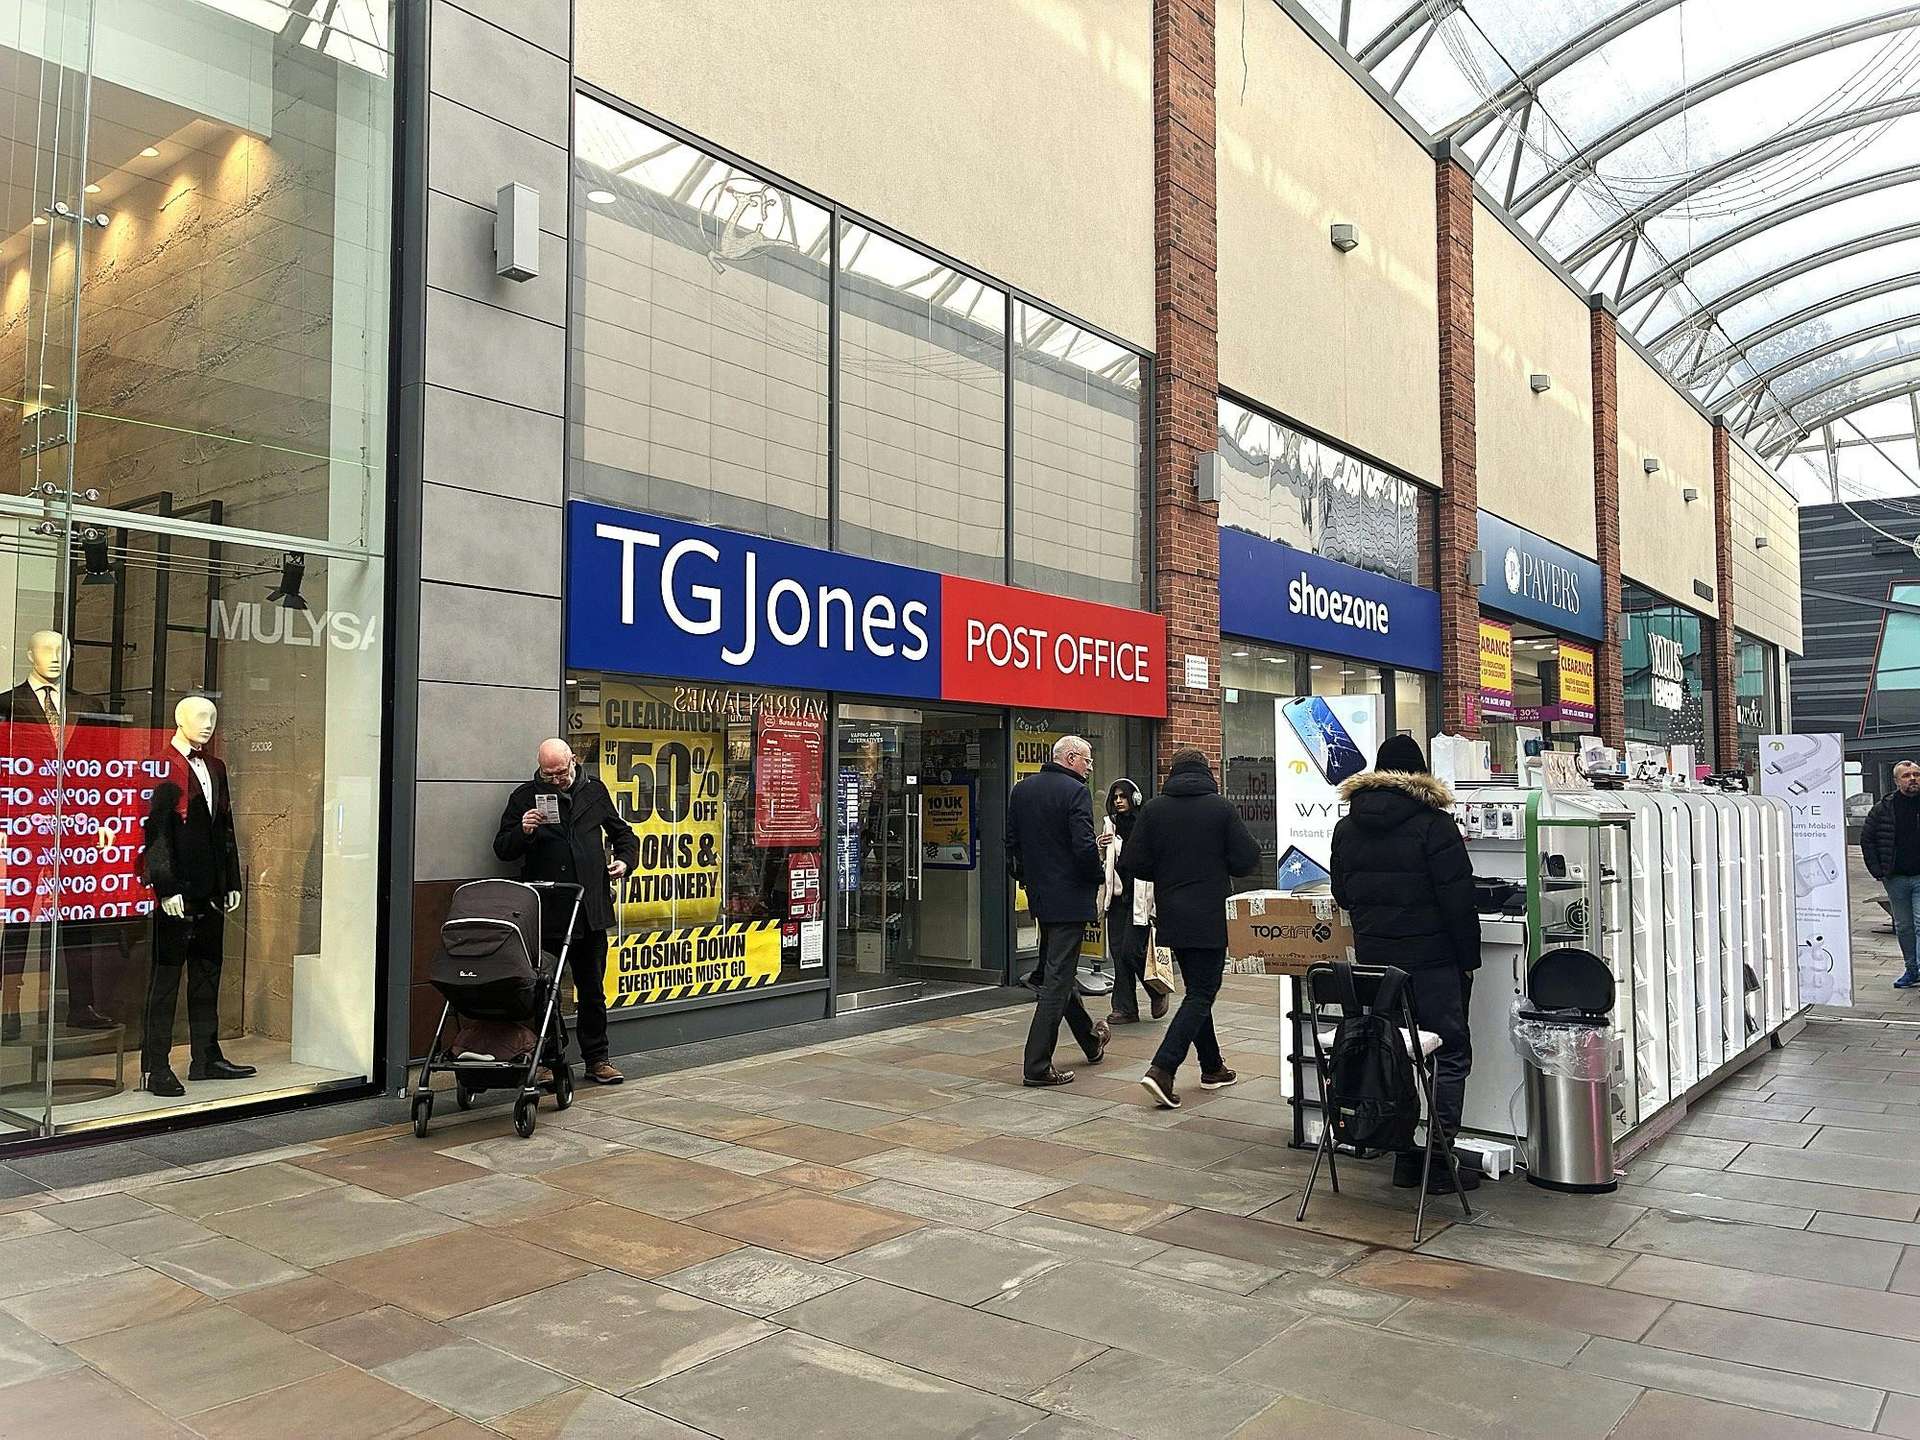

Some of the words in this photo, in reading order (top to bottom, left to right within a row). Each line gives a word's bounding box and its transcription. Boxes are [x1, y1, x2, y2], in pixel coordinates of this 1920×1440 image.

[1522, 552, 1580, 615] PAVERS
[1288, 570, 1390, 635] shoezone
[966, 619, 1048, 670] POST
[1054, 633, 1150, 683] OFFICE
[1480, 636, 1510, 659] ARANCE
[1561, 656, 1593, 677] CLEARANCE
[605, 699, 721, 733] CLEARANCE
[1520, 708, 1540, 717] 30%
[605, 741, 617, 752] UP
[1016, 742, 1054, 763] CLEAR
[605, 754, 617, 766] TO
[617, 741, 720, 823] 50%
[693, 801, 718, 821] OFF
[928, 797, 942, 810] 10
[943, 796, 963, 809] UK
[1791, 805, 1821, 816] YE
[1290, 827, 1324, 838] Instant
[1795, 830, 1827, 838] essories
[1808, 822, 1836, 830] Mobile
[697, 833, 718, 868] &
[619, 940, 692, 973] CLOSING
[696, 934, 746, 963] DOWN
[618, 967, 693, 994] EVERYTHING
[695, 963, 729, 985] MUST
[730, 960, 746, 977] GO
